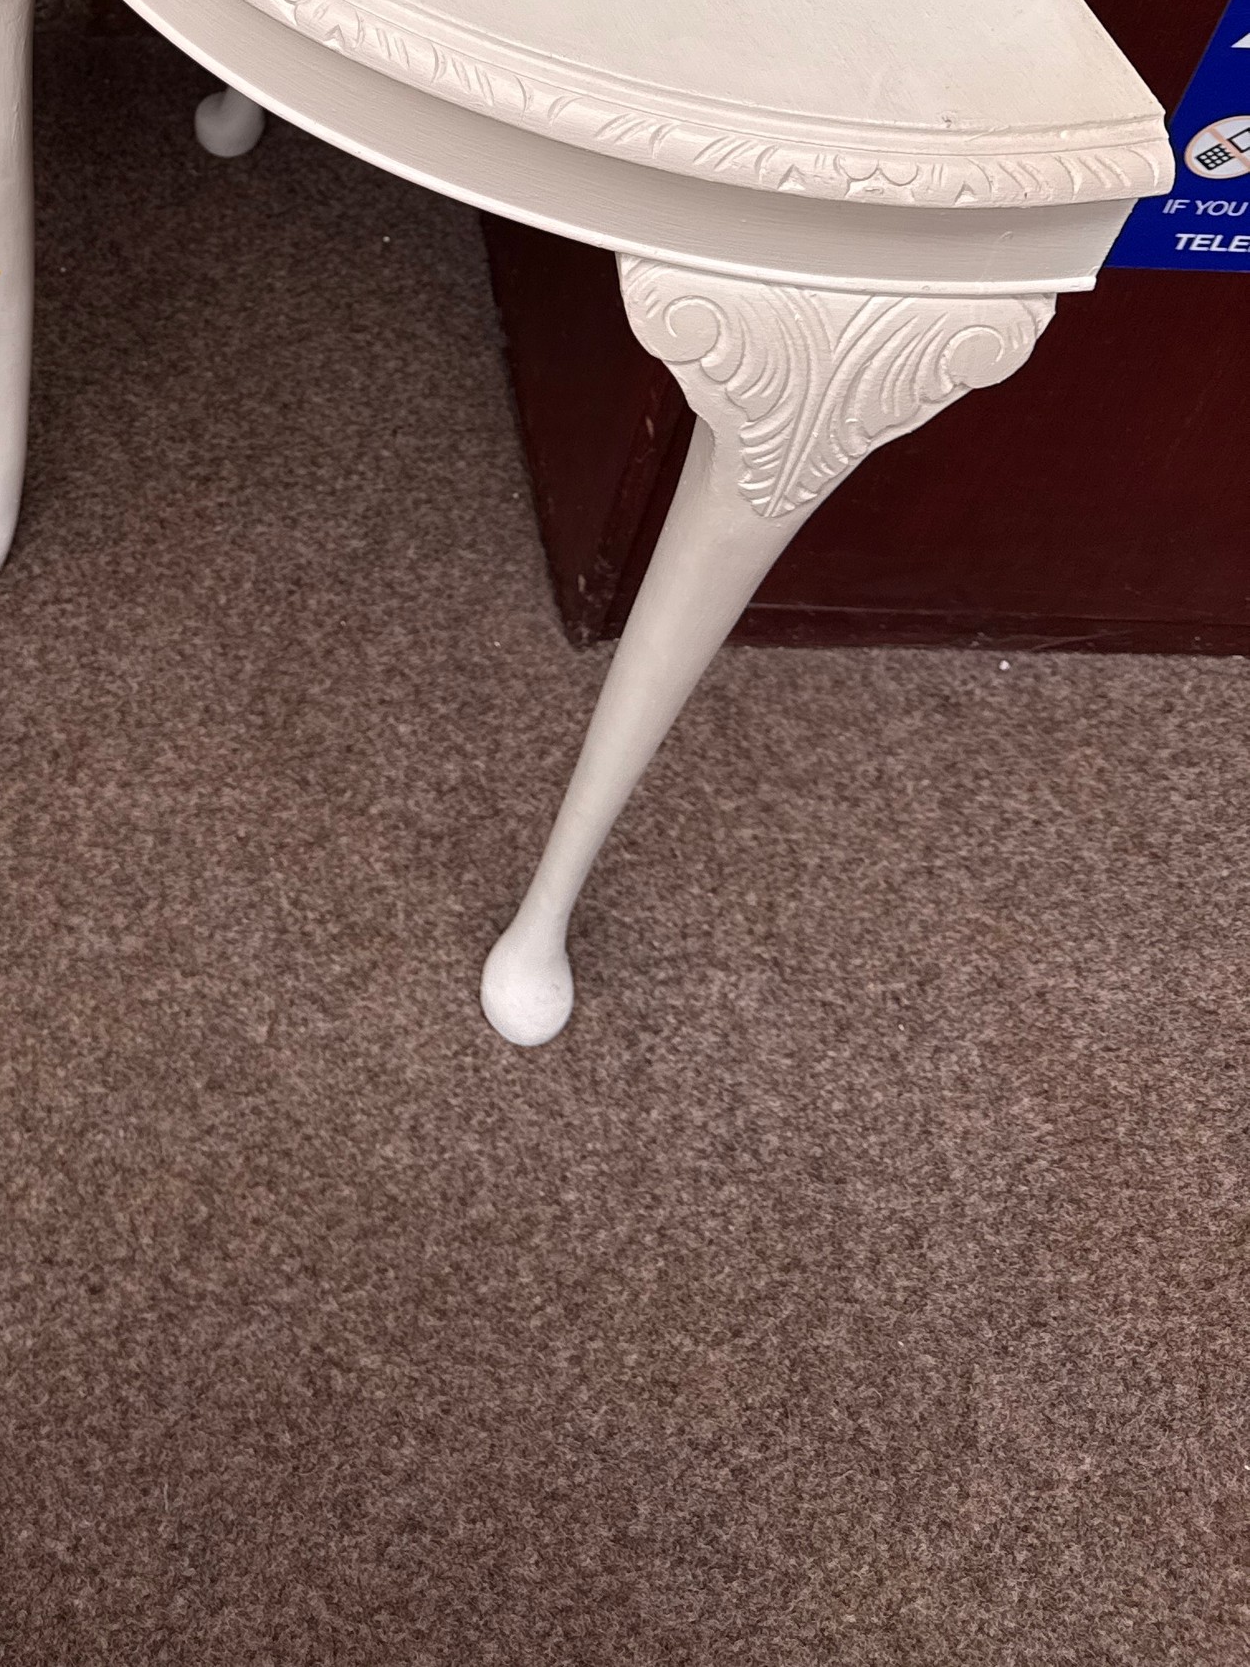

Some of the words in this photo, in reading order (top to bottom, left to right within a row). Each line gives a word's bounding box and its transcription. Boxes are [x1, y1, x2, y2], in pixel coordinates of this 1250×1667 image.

[1162, 199, 1190, 214] IF
[1195, 200, 1249, 216] YOU
[1175, 233, 1250, 252] TELE
